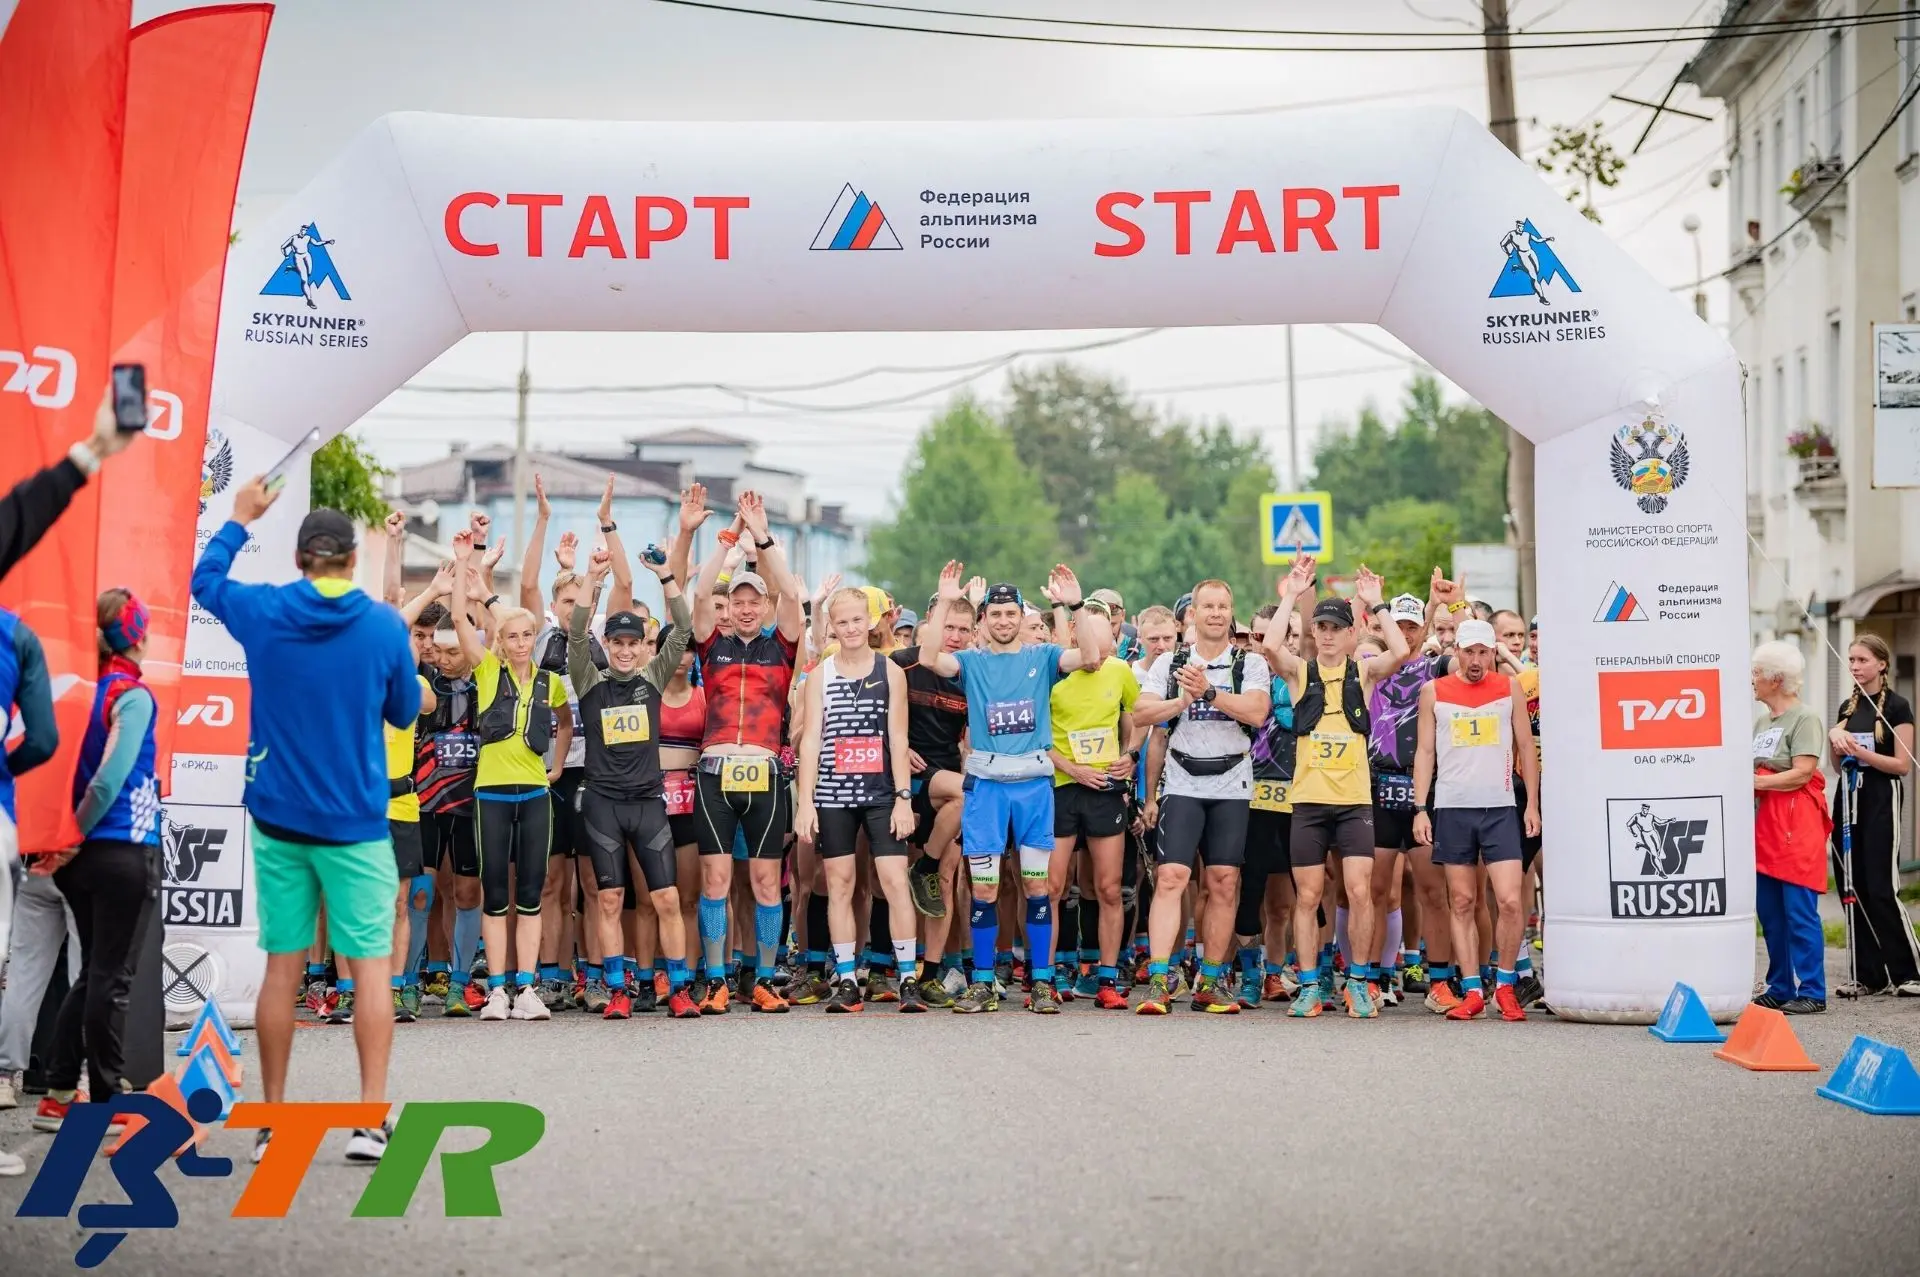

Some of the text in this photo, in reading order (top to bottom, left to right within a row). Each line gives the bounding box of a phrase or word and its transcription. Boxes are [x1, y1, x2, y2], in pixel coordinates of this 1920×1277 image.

[919, 189, 1030, 207] Федерация
[444, 191, 750, 260] СТАРТ
[919, 213, 1037, 226] альпинизма
[1094, 184, 1400, 257] START
[920, 234, 990, 249] России
[245, 328, 368, 348] RUSSIAN SERIES
[1482, 326, 1606, 344] RUSSIAN SERIES
[1588, 524, 1713, 536] МИНИСТЕРСТВО СПОРТА
[1586, 536, 1718, 548] РОССИЙСКОЙ ФЕДЕРАЦИИ
[1658, 583, 1719, 594] Федерация
[1658, 597, 1722, 607] альпинизма
[191, 615, 224, 625] Росс
[1659, 610, 1700, 620] России
[206, 660, 248, 671] СПОНСО
[1595, 653, 1721, 666] ГЕНЕРАЛЬНЫЙ СПОНСОР
[613, 715, 640, 732] 40
[995, 708, 1031, 726] 114
[1469, 719, 1481, 736] 1
[443, 743, 477, 758] 125
[1080, 736, 1105, 755] 57
[1320, 742, 1348, 759] 37
[843, 747, 878, 763] 259
[1634, 753, 1696, 765] ОАО «РЖД»
[732, 765, 759, 781] 60
[1259, 784, 1287, 803] 38
[1385, 786, 1415, 802] 135
[1617, 882, 1721, 916] RUSSIA
